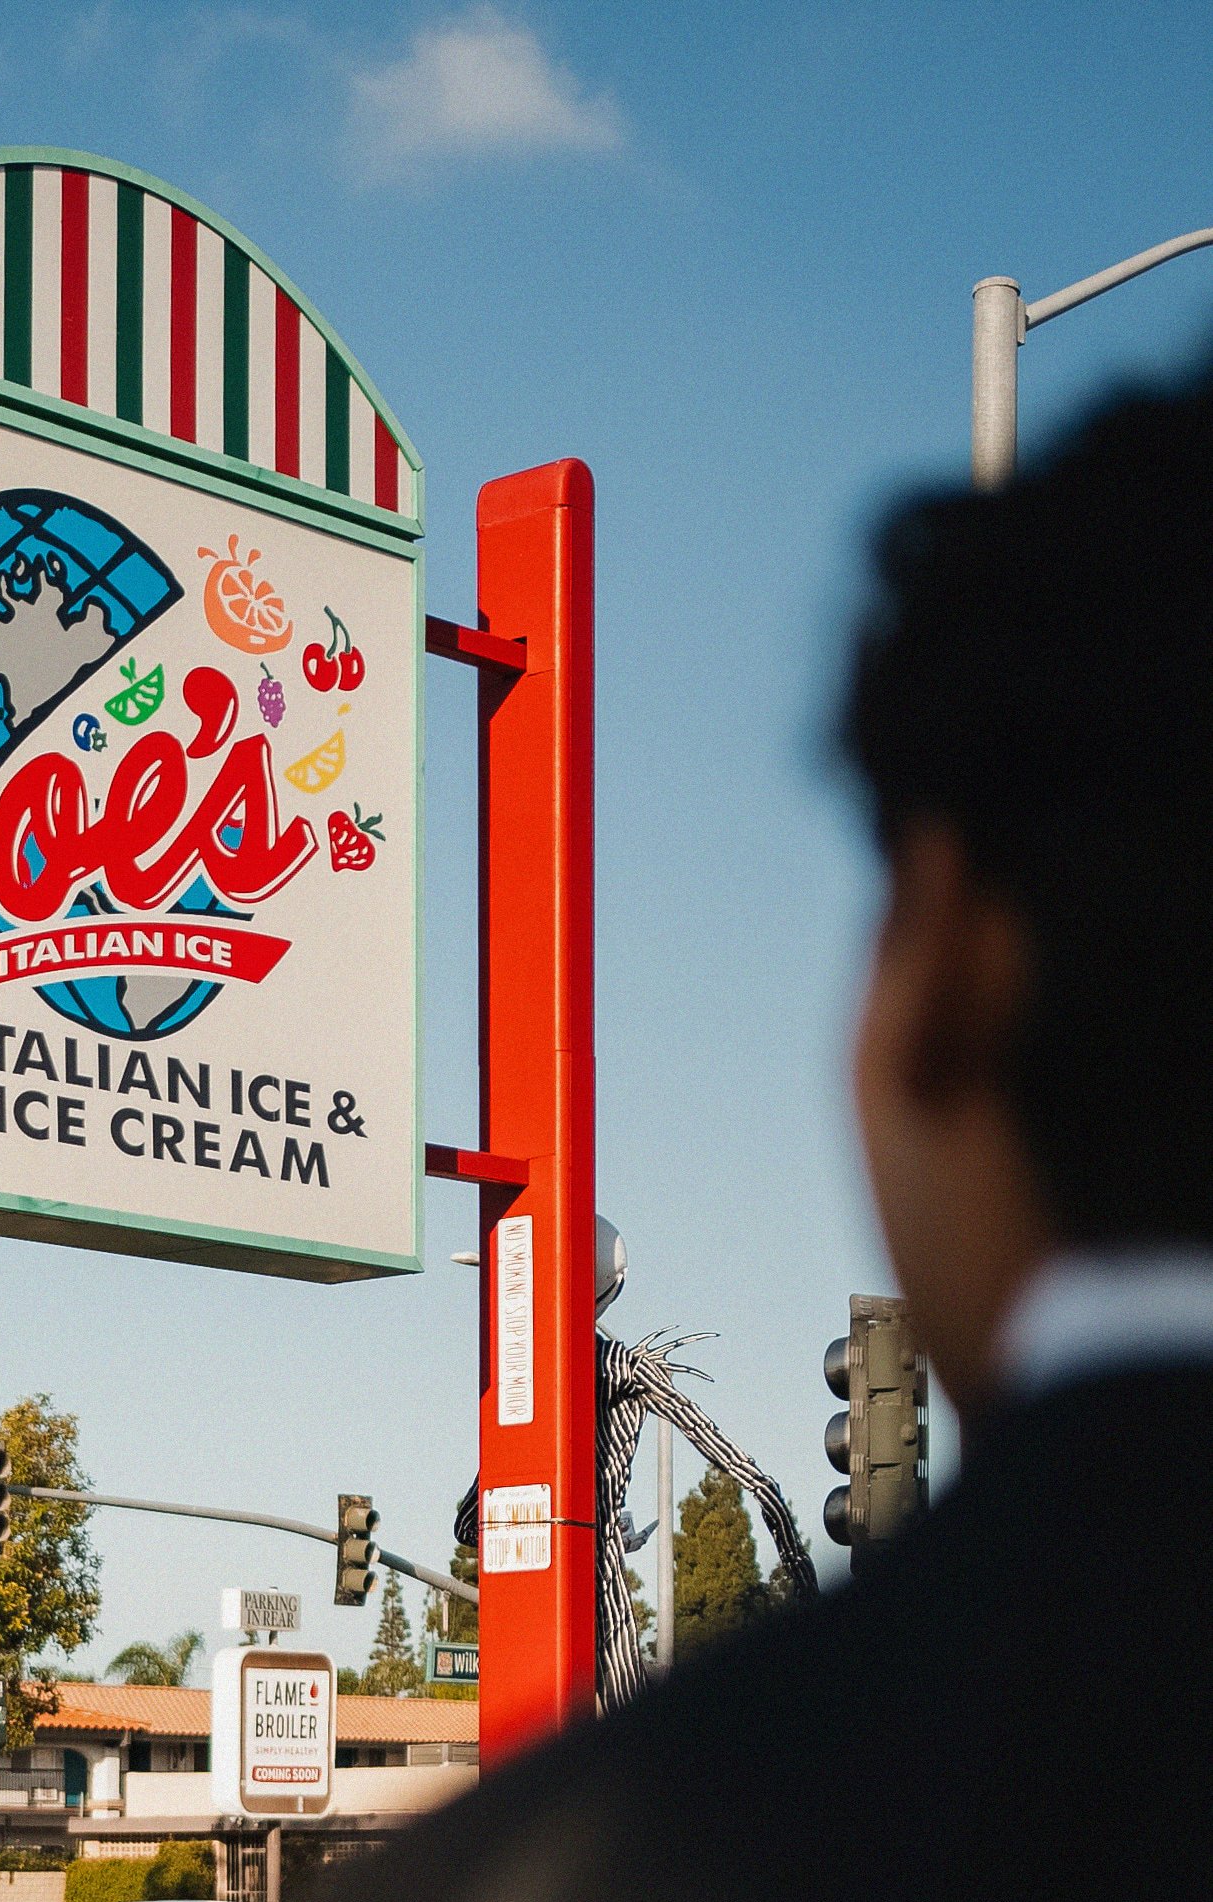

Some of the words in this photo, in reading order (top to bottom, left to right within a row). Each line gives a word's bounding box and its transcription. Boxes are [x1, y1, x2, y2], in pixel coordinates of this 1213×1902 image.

[173, 934, 233, 967] ICE
[230, 1067, 312, 1128] ICE
[326, 1089, 369, 1139] &
[109, 1107, 331, 1189] CREAM
[504, 1223, 526, 1241] NO
[504, 1243, 527, 1301] SMOKING
[505, 1304, 528, 1337] STOP
[505, 1340, 528, 1373] YOUR
[505, 1375, 528, 1417] MOTOR
[487, 1504, 499, 1532] NO
[505, 1500, 548, 1531] SMOKING
[488, 1537, 510, 1568] STOP
[515, 1535, 547, 1566] MOTOR
[244, 1592, 298, 1612] PARKING
[247, 1609, 261, 1626] IN
[263, 1611, 296, 1628] REAR
[255, 1680, 306, 1706] FLAME
[255, 1713, 318, 1739] BROILER
[255, 1767, 292, 1780] COMING
[292, 1767, 319, 1781] SOON
